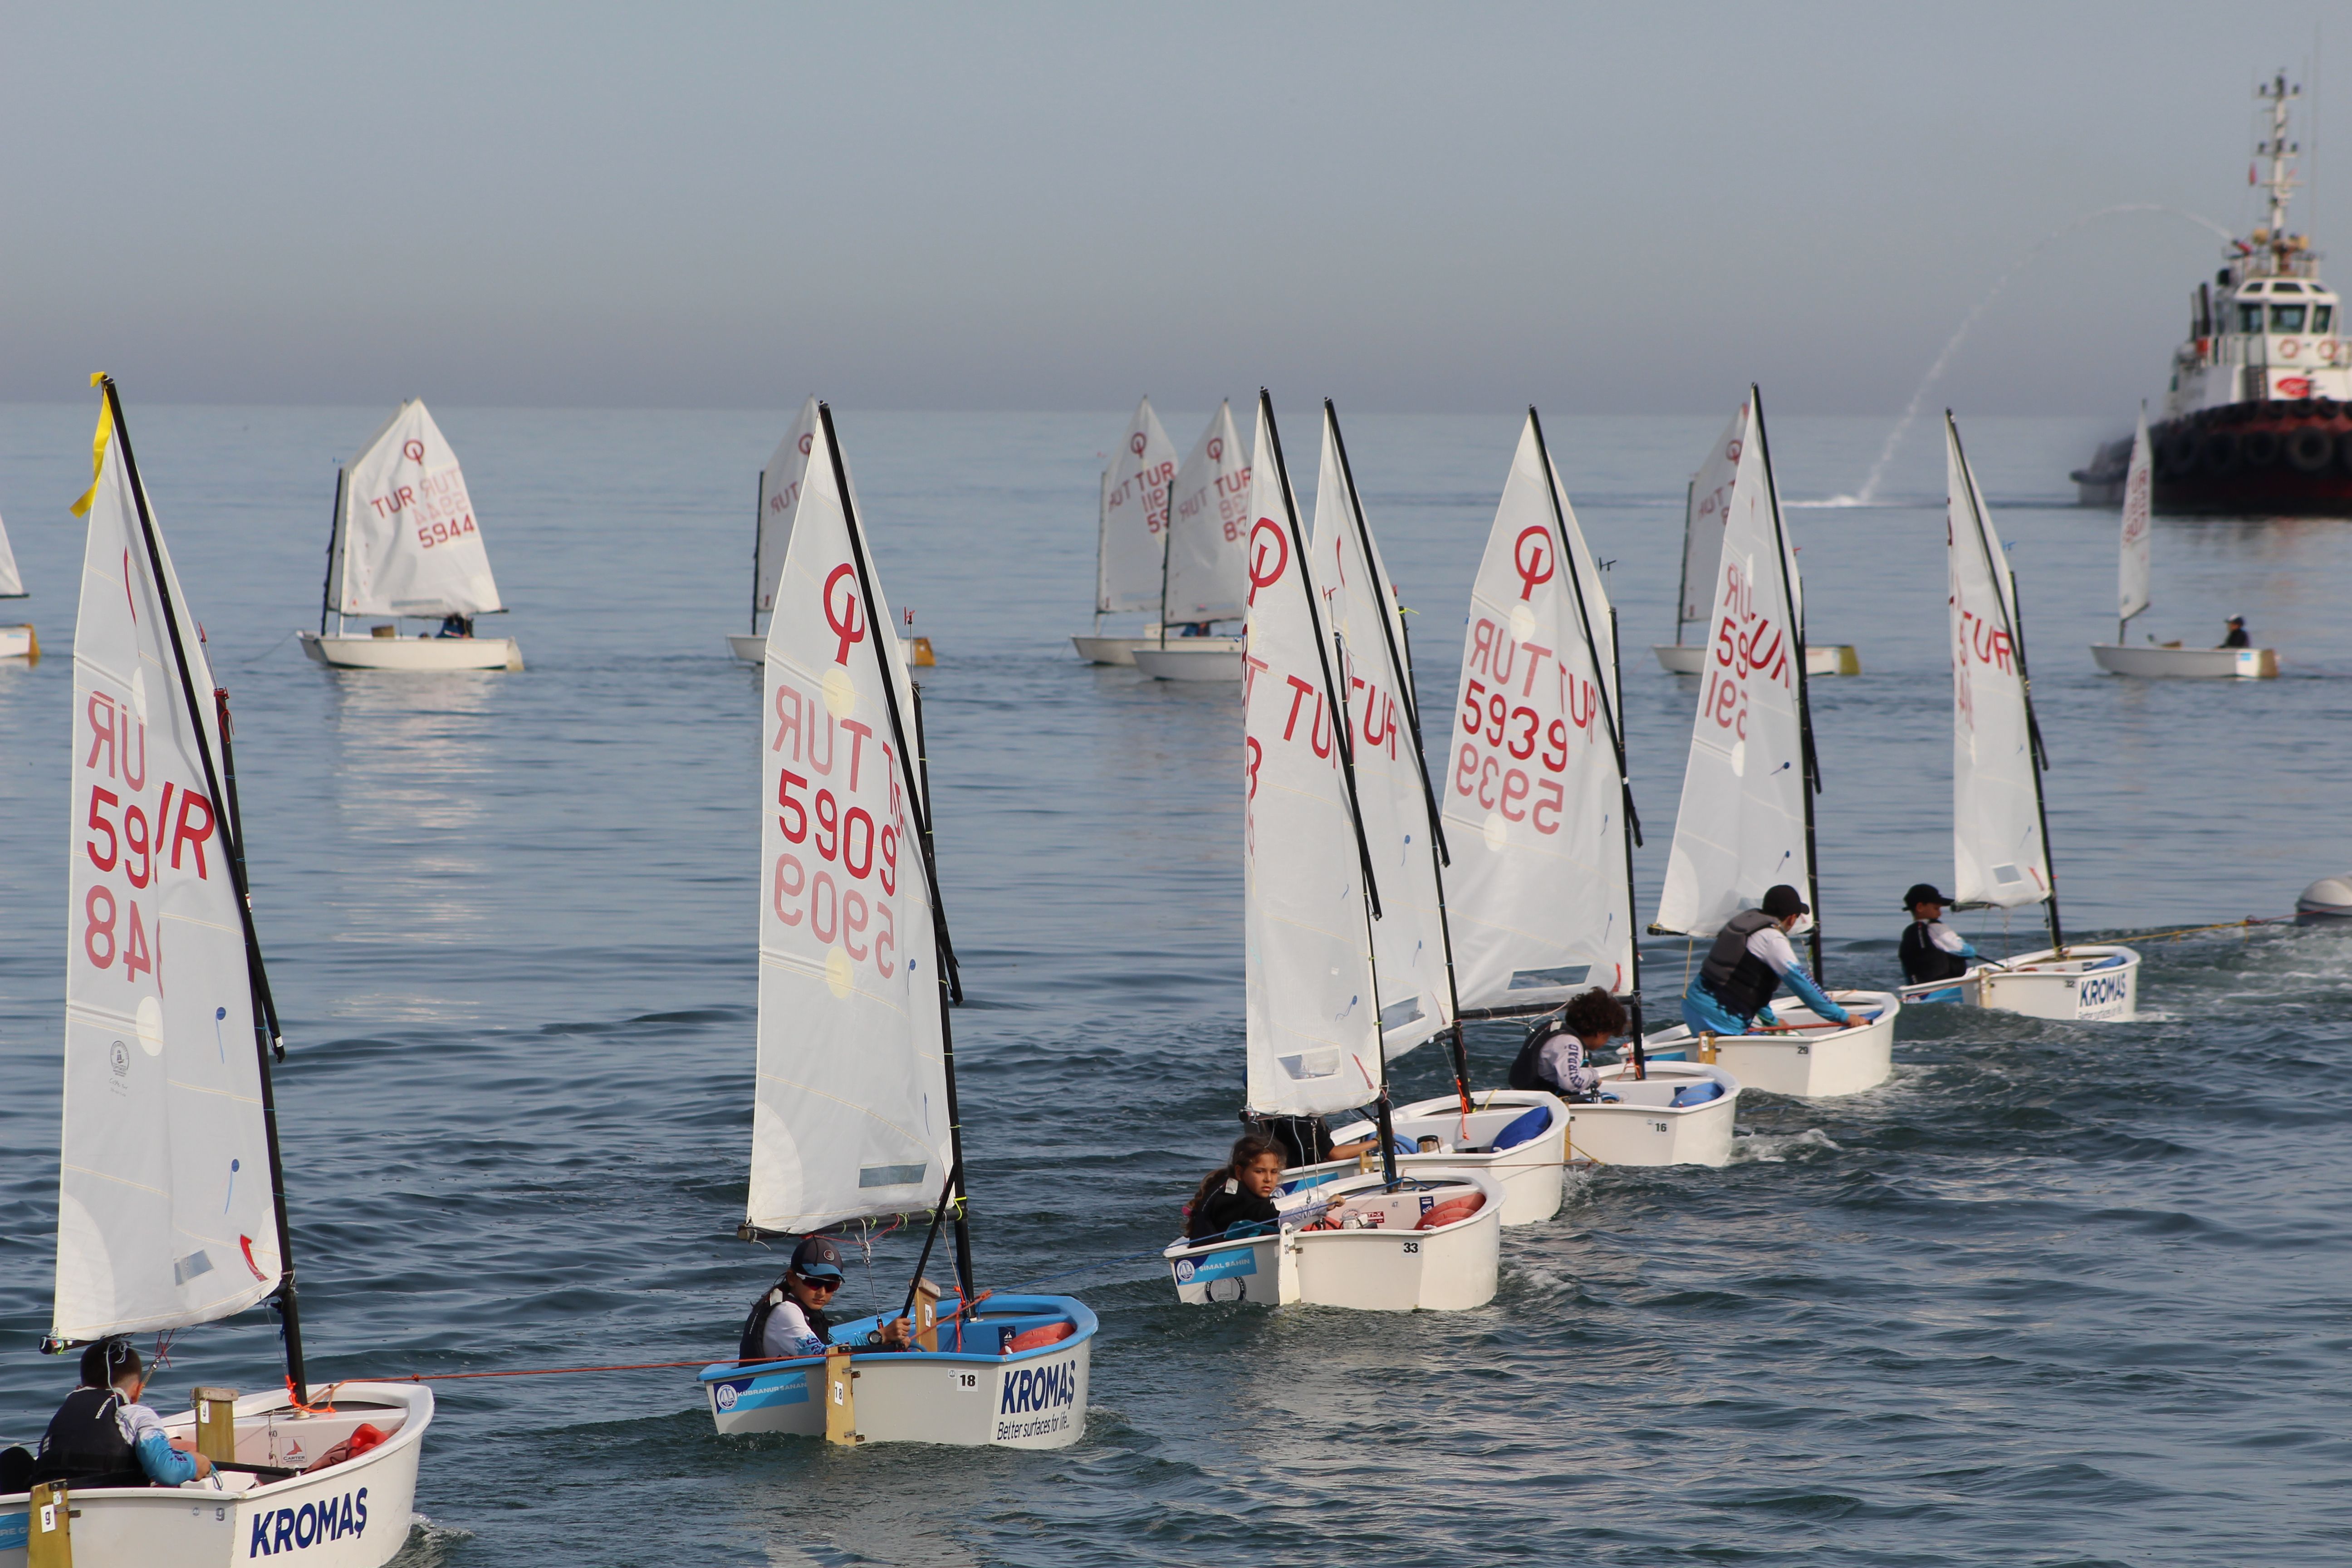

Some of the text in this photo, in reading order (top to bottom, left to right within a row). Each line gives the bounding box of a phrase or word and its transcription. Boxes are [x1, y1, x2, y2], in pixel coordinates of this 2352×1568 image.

[1135, 461, 1176, 491] TUR
[371, 486, 416, 519] TUR
[418, 514, 475, 549] 5944
[1147, 508, 1168, 534] 59
[1716, 616, 1749, 680] 59
[1558, 659, 1596, 744] TUR
[1284, 675, 1336, 769] TU
[1462, 678, 1567, 773] 5939
[87, 785, 157, 889] 59
[779, 768, 897, 897] 5909
[1798, 1046, 1808, 1054] 29
[1655, 1123, 1667, 1132] 16
[1403, 1242, 1418, 1254] 33
[737, 1387, 779, 1397] KÜBRANUR
[835, 1386, 842, 1400] 18
[960, 1375, 976, 1387] 18
[1001, 1360, 1076, 1415] KROMAŞ
[997, 1420, 1023, 1440] Better
[1023, 1416, 1050, 1437] surfaces
[1051, 1413, 1059, 1433] for
[45, 1511, 51, 1525] 9
[216, 1507, 225, 1521] 9
[250, 1487, 368, 1558] KROMAŞ
